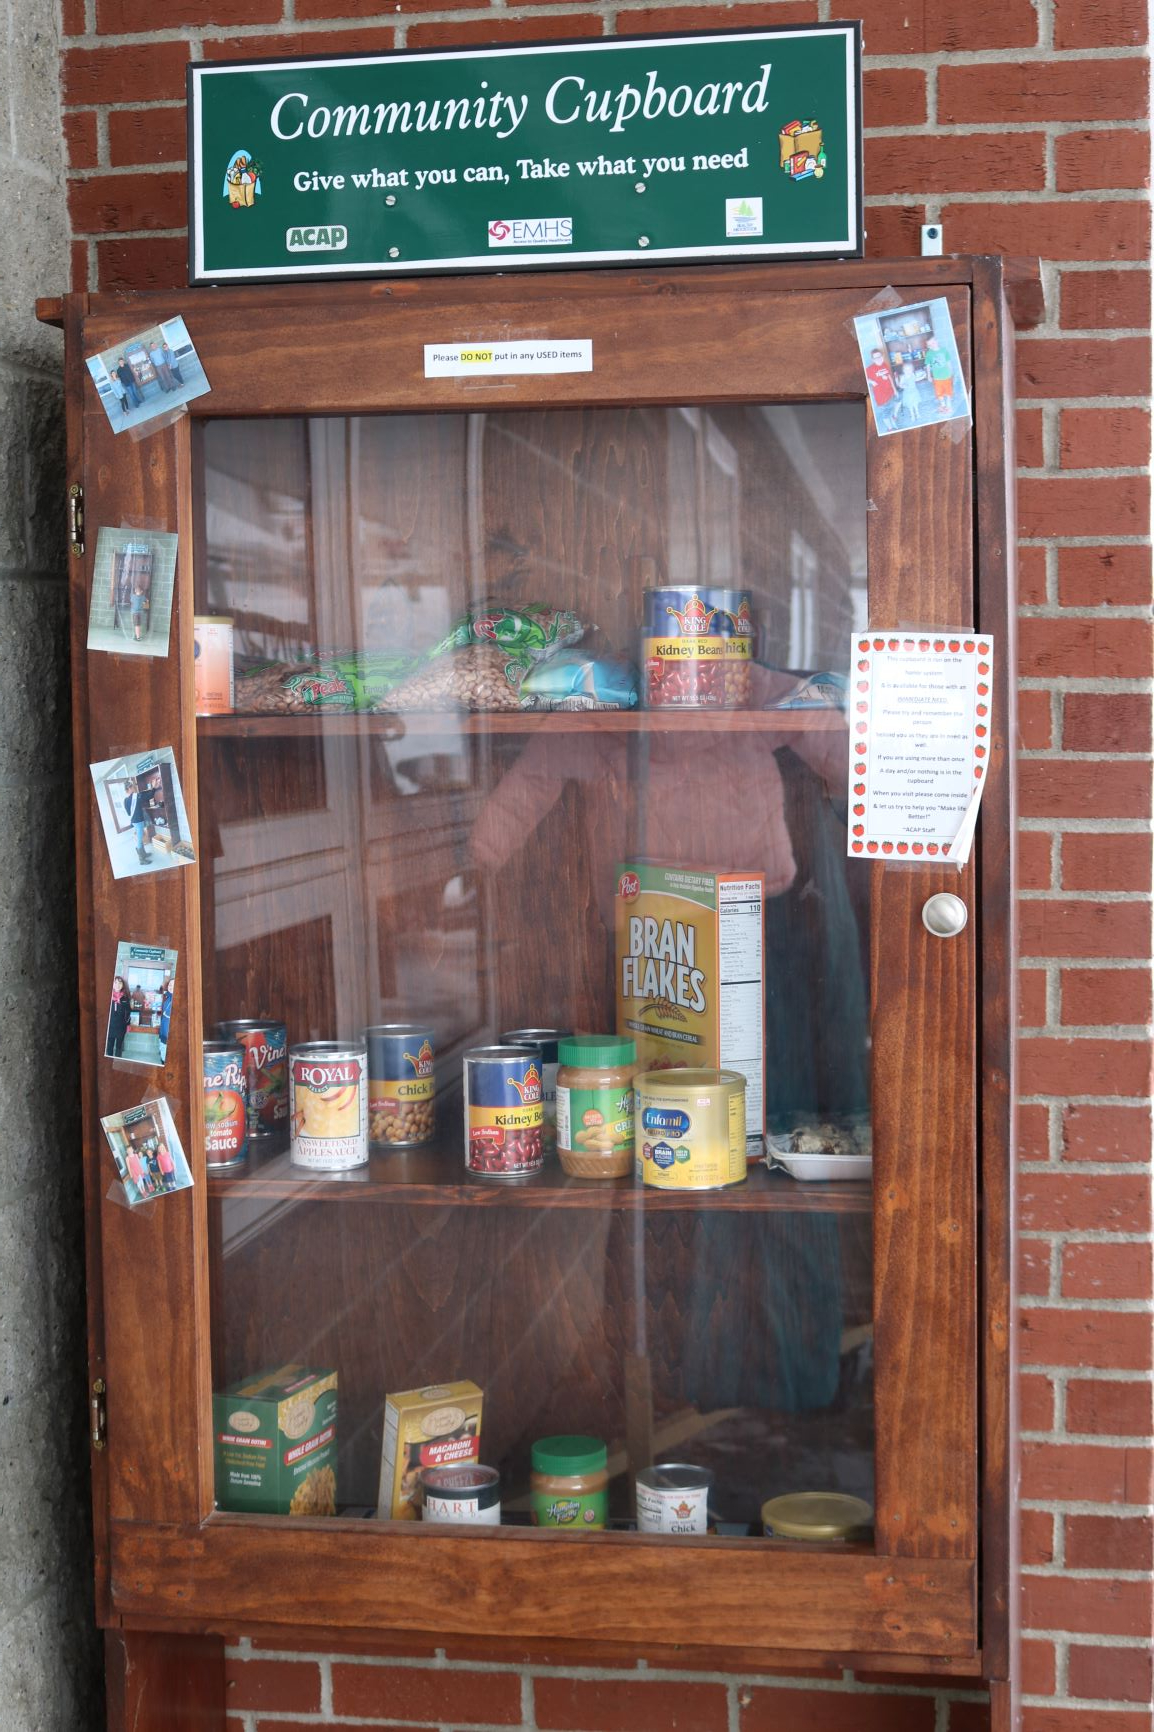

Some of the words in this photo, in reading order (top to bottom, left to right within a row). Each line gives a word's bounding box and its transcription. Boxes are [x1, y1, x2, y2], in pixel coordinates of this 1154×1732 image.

[270, 80, 528, 140] Community
[545, 63, 772, 133] Cupboard
[293, 170, 345, 192] Give
[351, 167, 409, 188] what
[415, 166, 457, 190] you
[463, 164, 510, 184] can,
[516, 158, 570, 179] Take
[577, 155, 637, 177] what
[642, 154, 685, 178] you
[691, 148, 749, 169] need
[513, 220, 572, 239] EMHS
[289, 227, 345, 248] ACAP
[433, 354, 459, 362] Please
[460, 353, 474, 361] DO
[475, 353, 493, 361] NOT
[494, 353, 508, 362] put
[510, 352, 518, 360] in
[519, 353, 534, 361] any
[536, 351, 558, 359] USED
[559, 350, 583, 358] items
[684, 616, 707, 624] KING
[684, 624, 707, 632] COLE
[656, 645, 694, 657] Kidney
[725, 642, 747, 654] hick
[311, 679, 347, 700] Peak
[622, 876, 638, 896] Post
[629, 915, 696, 968] BRAN
[622, 956, 706, 1014] FLAKES
[203, 1074, 223, 1088] ne
[301, 1067, 354, 1086] ROYAL
[397, 1084, 428, 1096] Chick
[217, 1120, 238, 1129] sodium
[495, 1114, 532, 1126] Kidney
[646, 1112, 682, 1127] Enfamil
[210, 1128, 233, 1137] tomato
[205, 1136, 237, 1151] Sauce
[298, 1138, 358, 1147] UNSWEETENED
[297, 1147, 356, 1157] APPLESAUCE
[428, 1440, 473, 1456] MACARONI
[435, 1455, 442, 1463] &
[443, 1447, 474, 1461] CHEESE
[427, 1497, 477, 1514] HART
[671, 1524, 696, 1533] Chick
